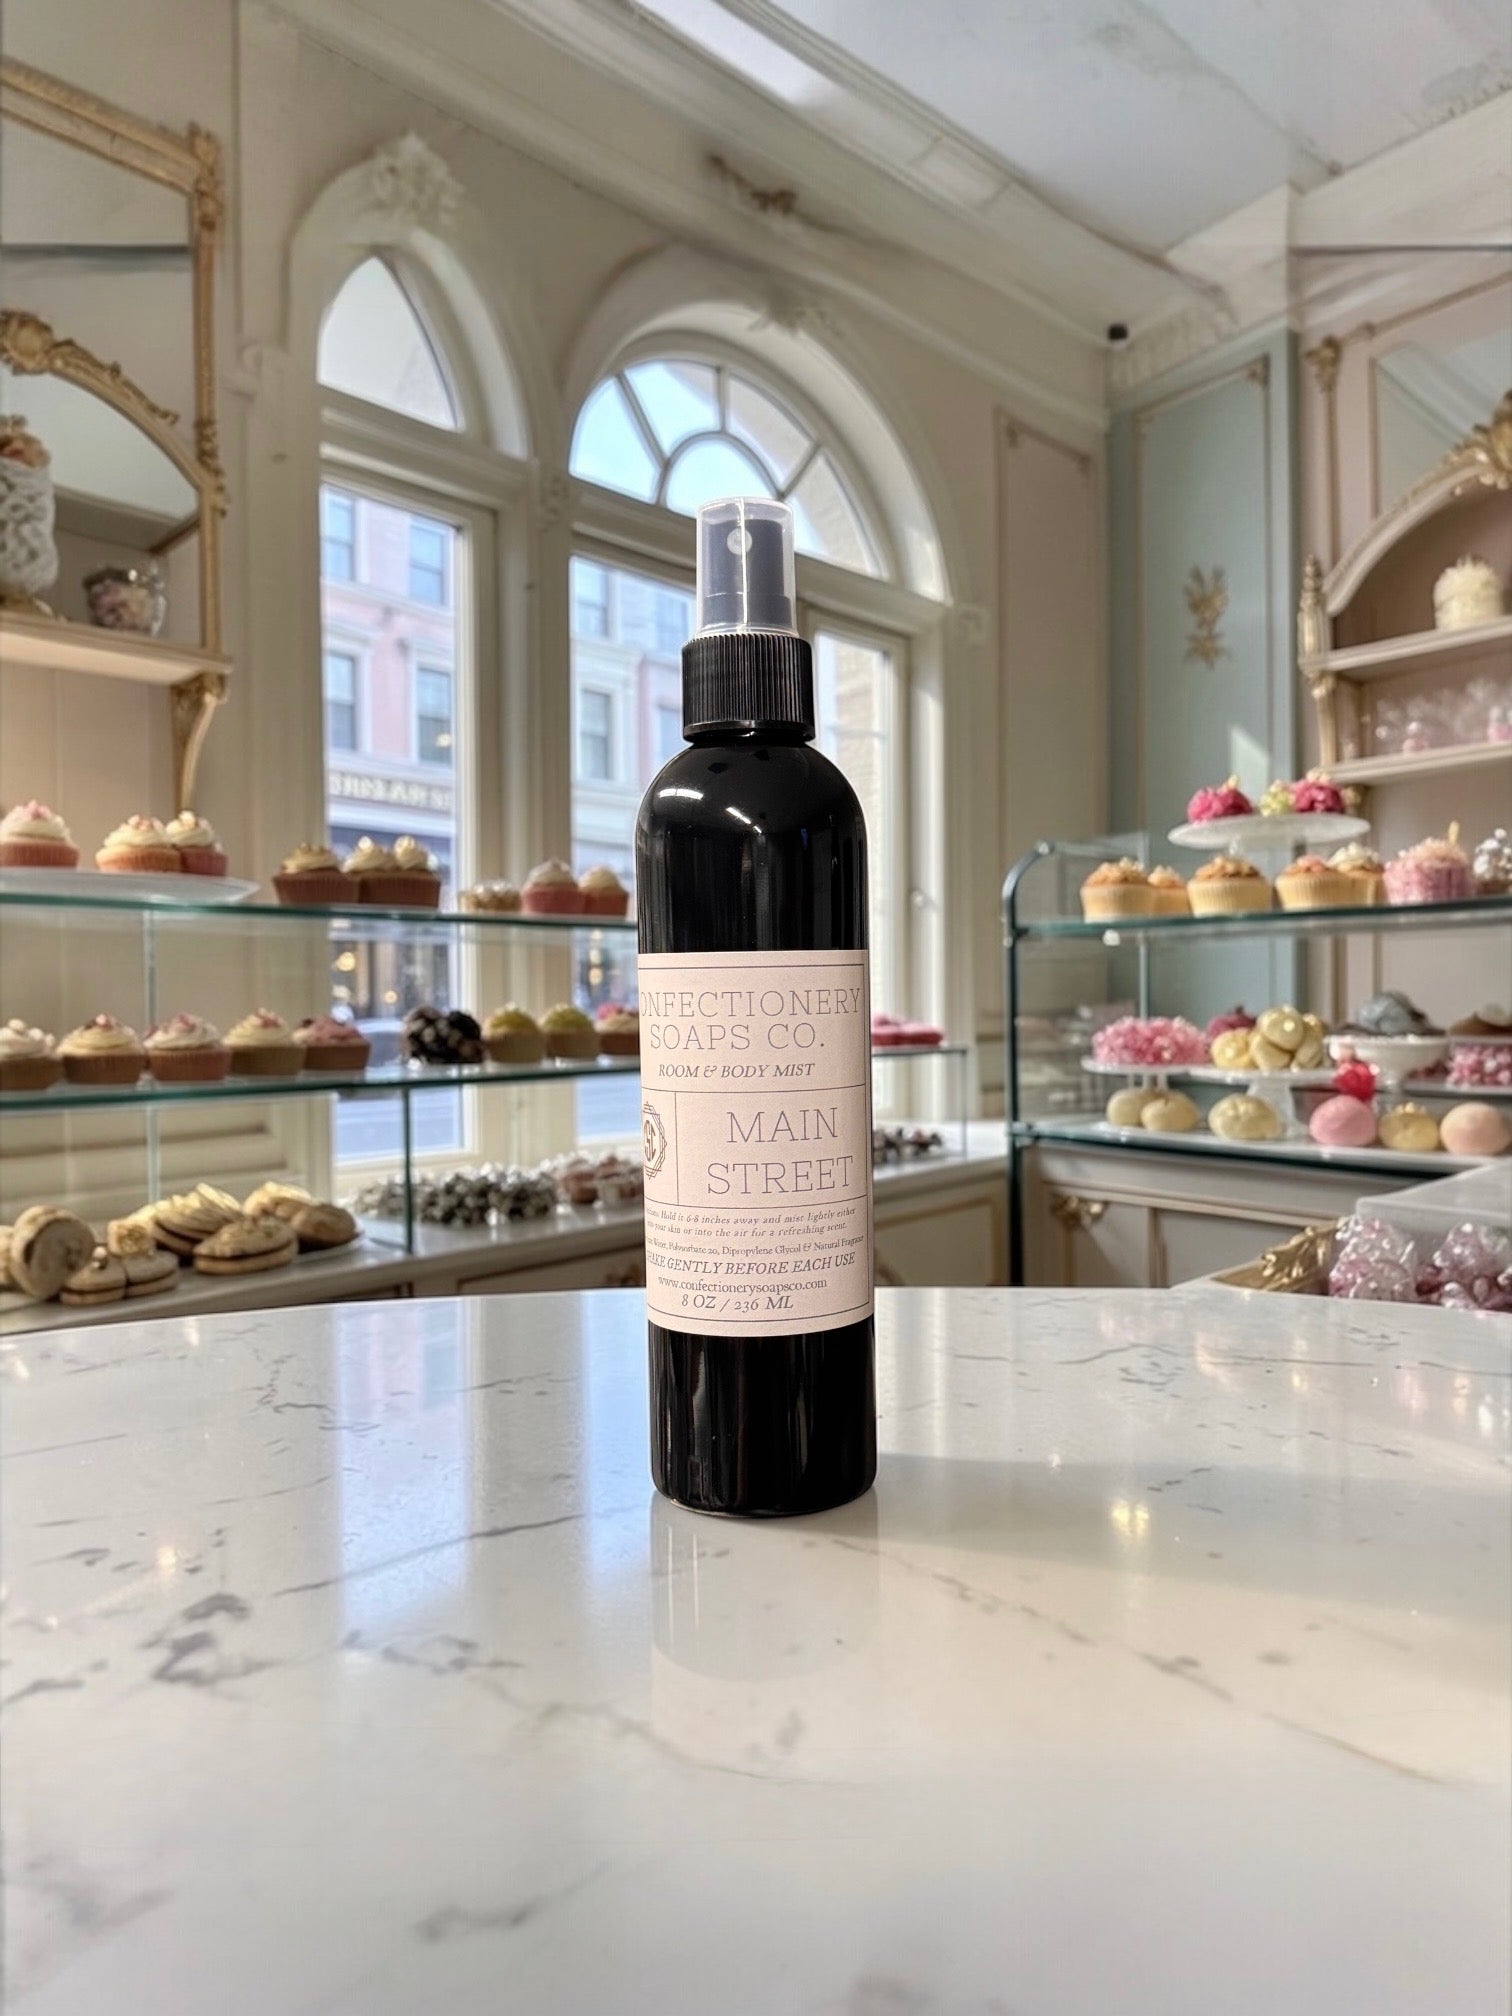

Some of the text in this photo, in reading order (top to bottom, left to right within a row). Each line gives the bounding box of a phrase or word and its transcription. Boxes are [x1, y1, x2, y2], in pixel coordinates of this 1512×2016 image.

[650, 1023, 824, 1050] SOAPS CO.
[658, 1063, 815, 1078] ROOM & BODY MIST
[727, 1107, 838, 1143] MAIN
[707, 1155, 853, 1194] STREET
[701, 1215, 730, 1224] inches
[733, 1217, 759, 1225] away
[763, 1214, 781, 1224] and
[784, 1214, 804, 1223] mist
[808, 1209, 835, 1222] lightly
[695, 1227, 712, 1236] into
[715, 1228, 731, 1237] the
[733, 1228, 748, 1237] air
[751, 1227, 766, 1237] for
[778, 1225, 826, 1236] refreshing
[708, 1248, 720, 1256] 20,
[722, 1246, 773, 1257] Dipropylene
[775, 1244, 800, 1255] Glycol
[803, 1242, 811, 1251] &
[814, 1239, 840, 1250] Natural
[667, 1257, 722, 1274] GENTLY
[724, 1261, 789, 1275] BEFORE
[792, 1256, 832, 1273] EACH
[835, 1252, 855, 1267] USE
[658, 1276, 827, 1296] www.confectionerysoapsco.com
[681, 1293, 794, 1313] 8 OZ / 236 ML
